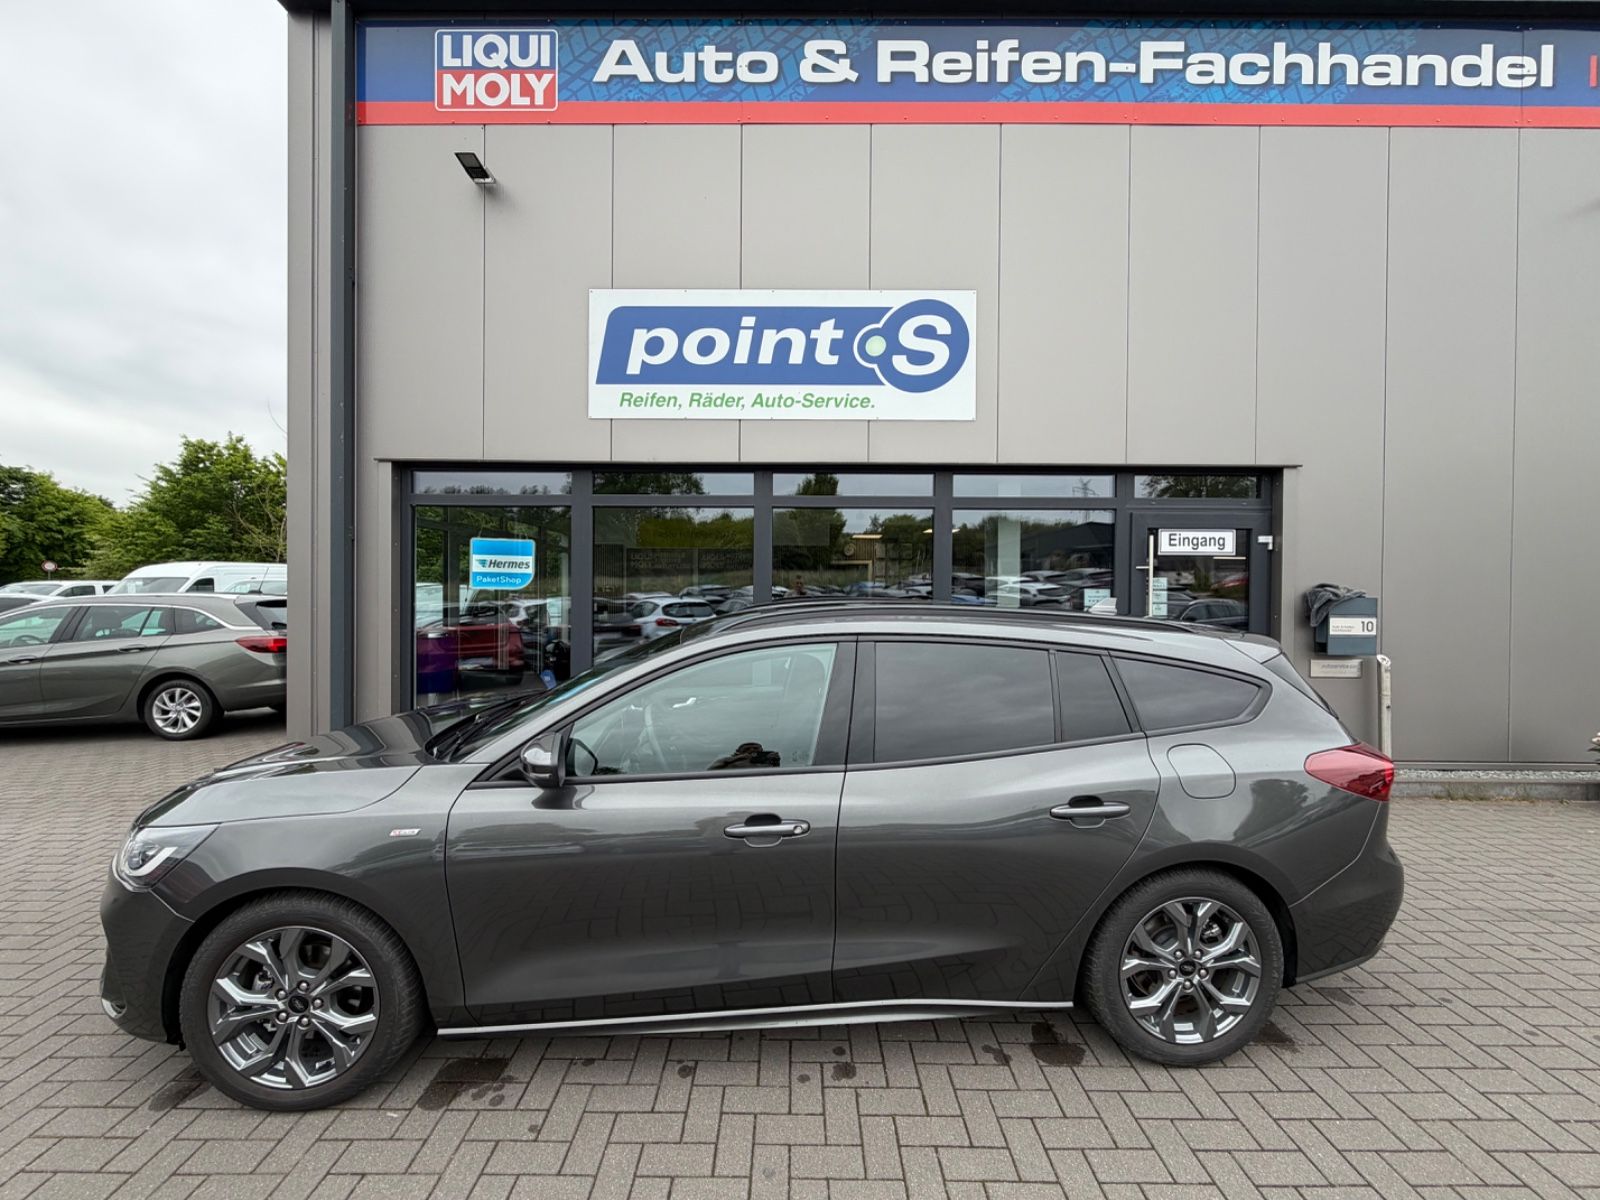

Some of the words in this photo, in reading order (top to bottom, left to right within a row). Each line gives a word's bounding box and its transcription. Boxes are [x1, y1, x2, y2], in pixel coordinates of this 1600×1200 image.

[442, 34, 551, 69] LIQUI
[592, 40, 779, 83] Auto
[799, 40, 858, 83] &
[877, 40, 1554, 88] Reifen-Fachhandel
[442, 73, 553, 107] MOLY
[626, 316, 845, 375] point
[891, 314, 952, 376] S
[619, 392, 683, 409] Reifen,
[688, 392, 746, 409] Räder,
[751, 392, 876, 409] Auto-Service.
[1168, 533, 1226, 551] Eingang
[488, 559, 530, 570] Hermes
[476, 575, 522, 585] PaketShop
[1361, 620, 1374, 633] 10
